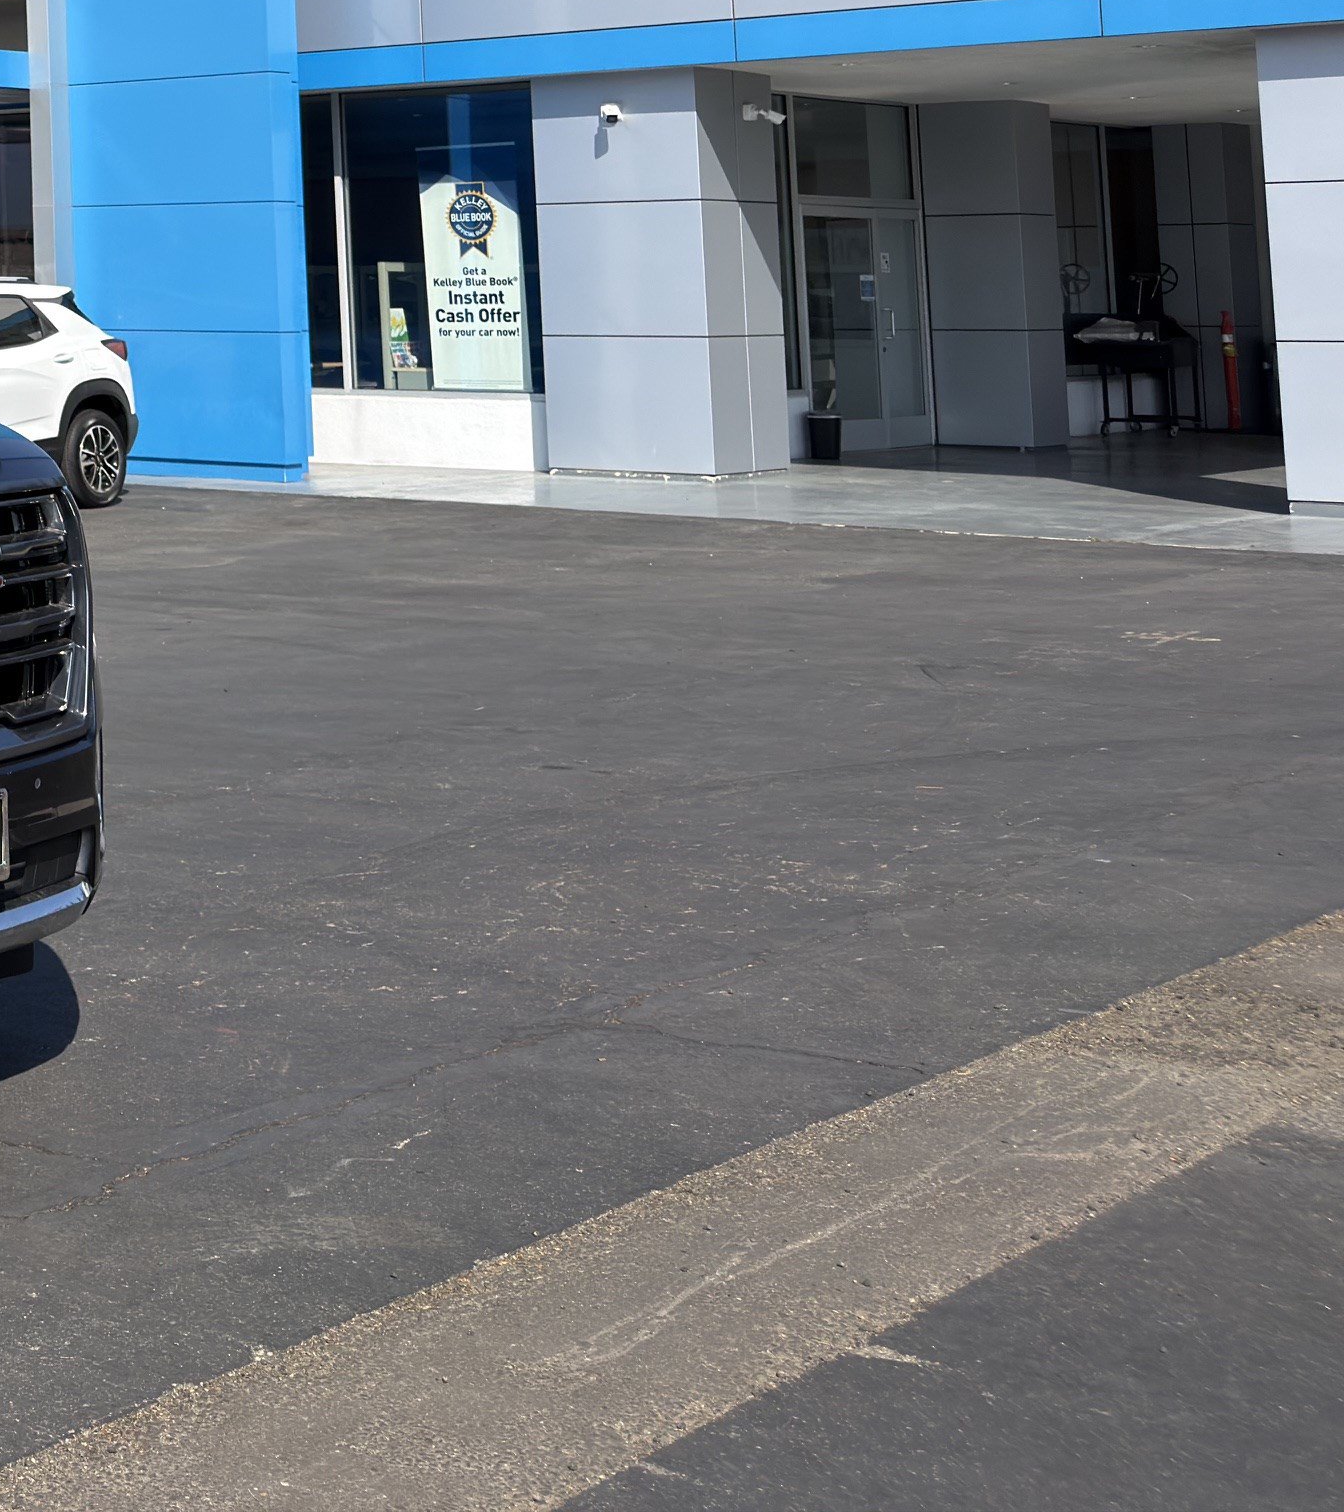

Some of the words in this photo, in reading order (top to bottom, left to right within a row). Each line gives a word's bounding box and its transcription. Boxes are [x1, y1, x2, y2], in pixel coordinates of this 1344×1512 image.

[454, 196, 490, 211] KELLEY
[450, 212, 471, 223] BLUE
[471, 212, 492, 223] BOOK
[462, 266, 479, 276] Get
[433, 277, 463, 288] Kelley
[465, 277, 487, 286] Blue
[448, 290, 505, 305] Instant
[435, 308, 475, 323] Cash
[478, 308, 521, 323] Offer
[438, 327, 452, 337] for
[453, 329, 476, 338] your
[478, 329, 494, 337] car
[496, 327, 520, 337] now!
